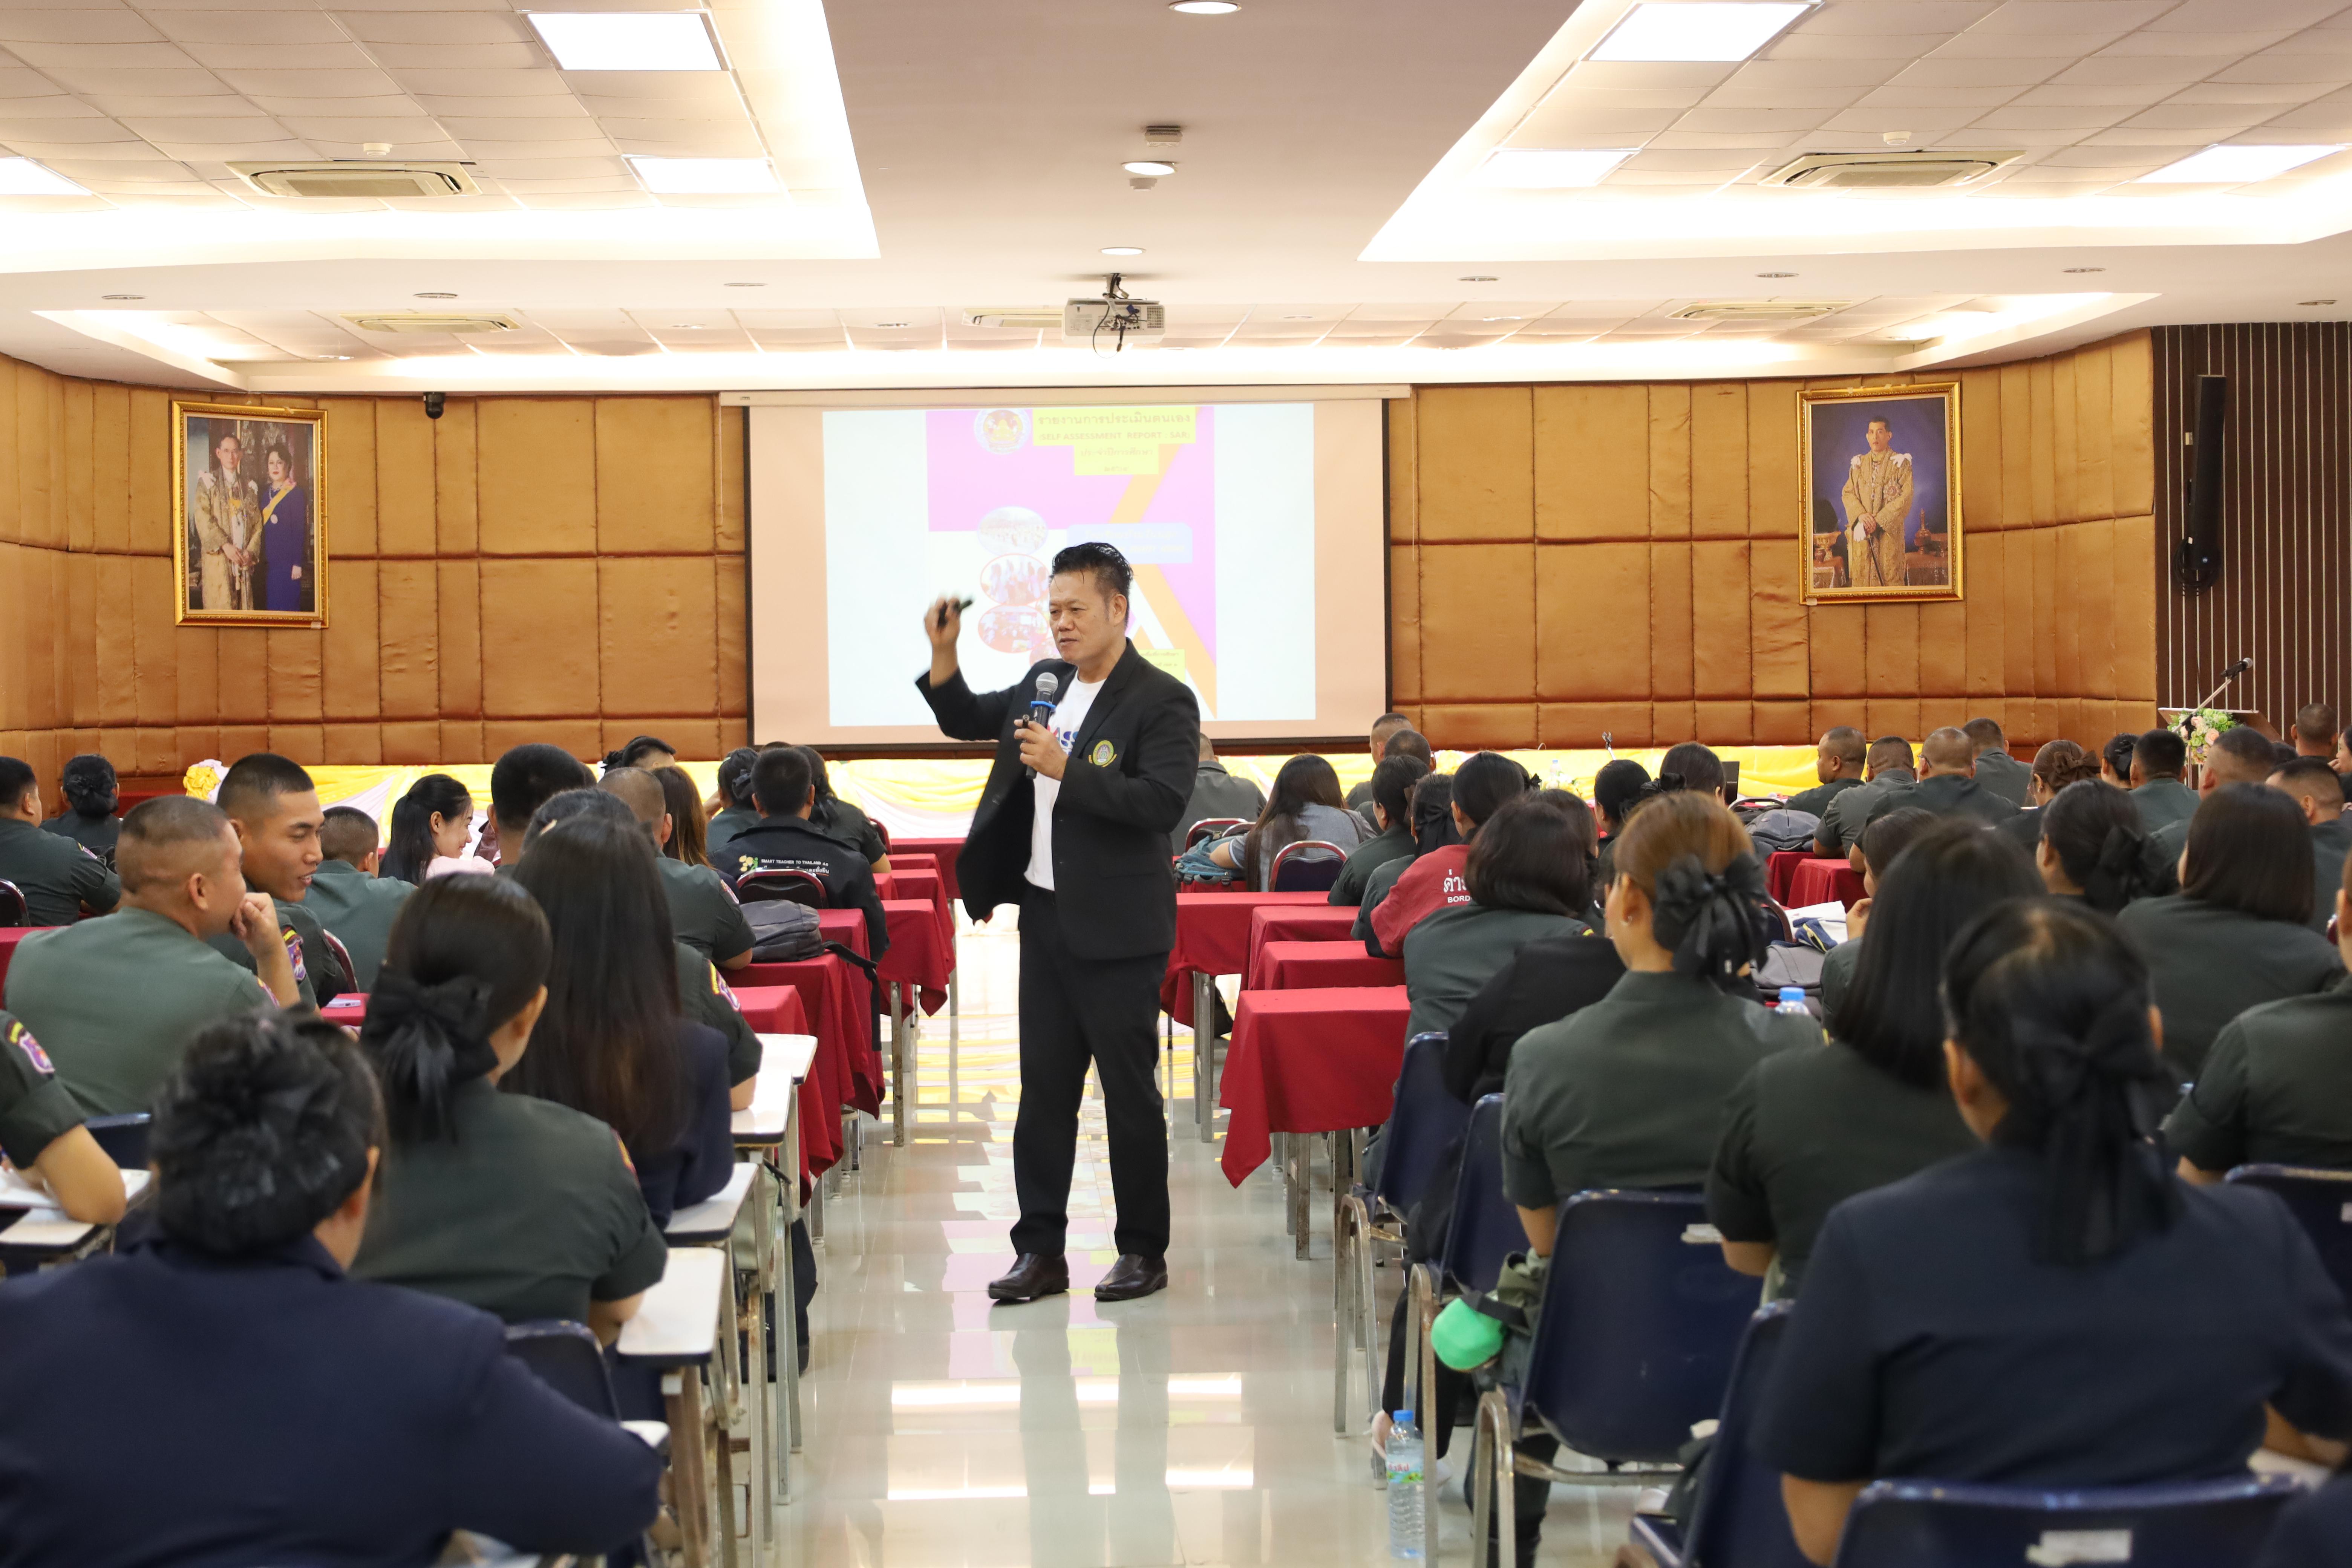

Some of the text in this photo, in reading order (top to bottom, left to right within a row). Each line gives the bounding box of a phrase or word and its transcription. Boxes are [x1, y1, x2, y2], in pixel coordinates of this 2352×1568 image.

[1038, 412, 1190, 425] รายงานการประเมินตนเอง
